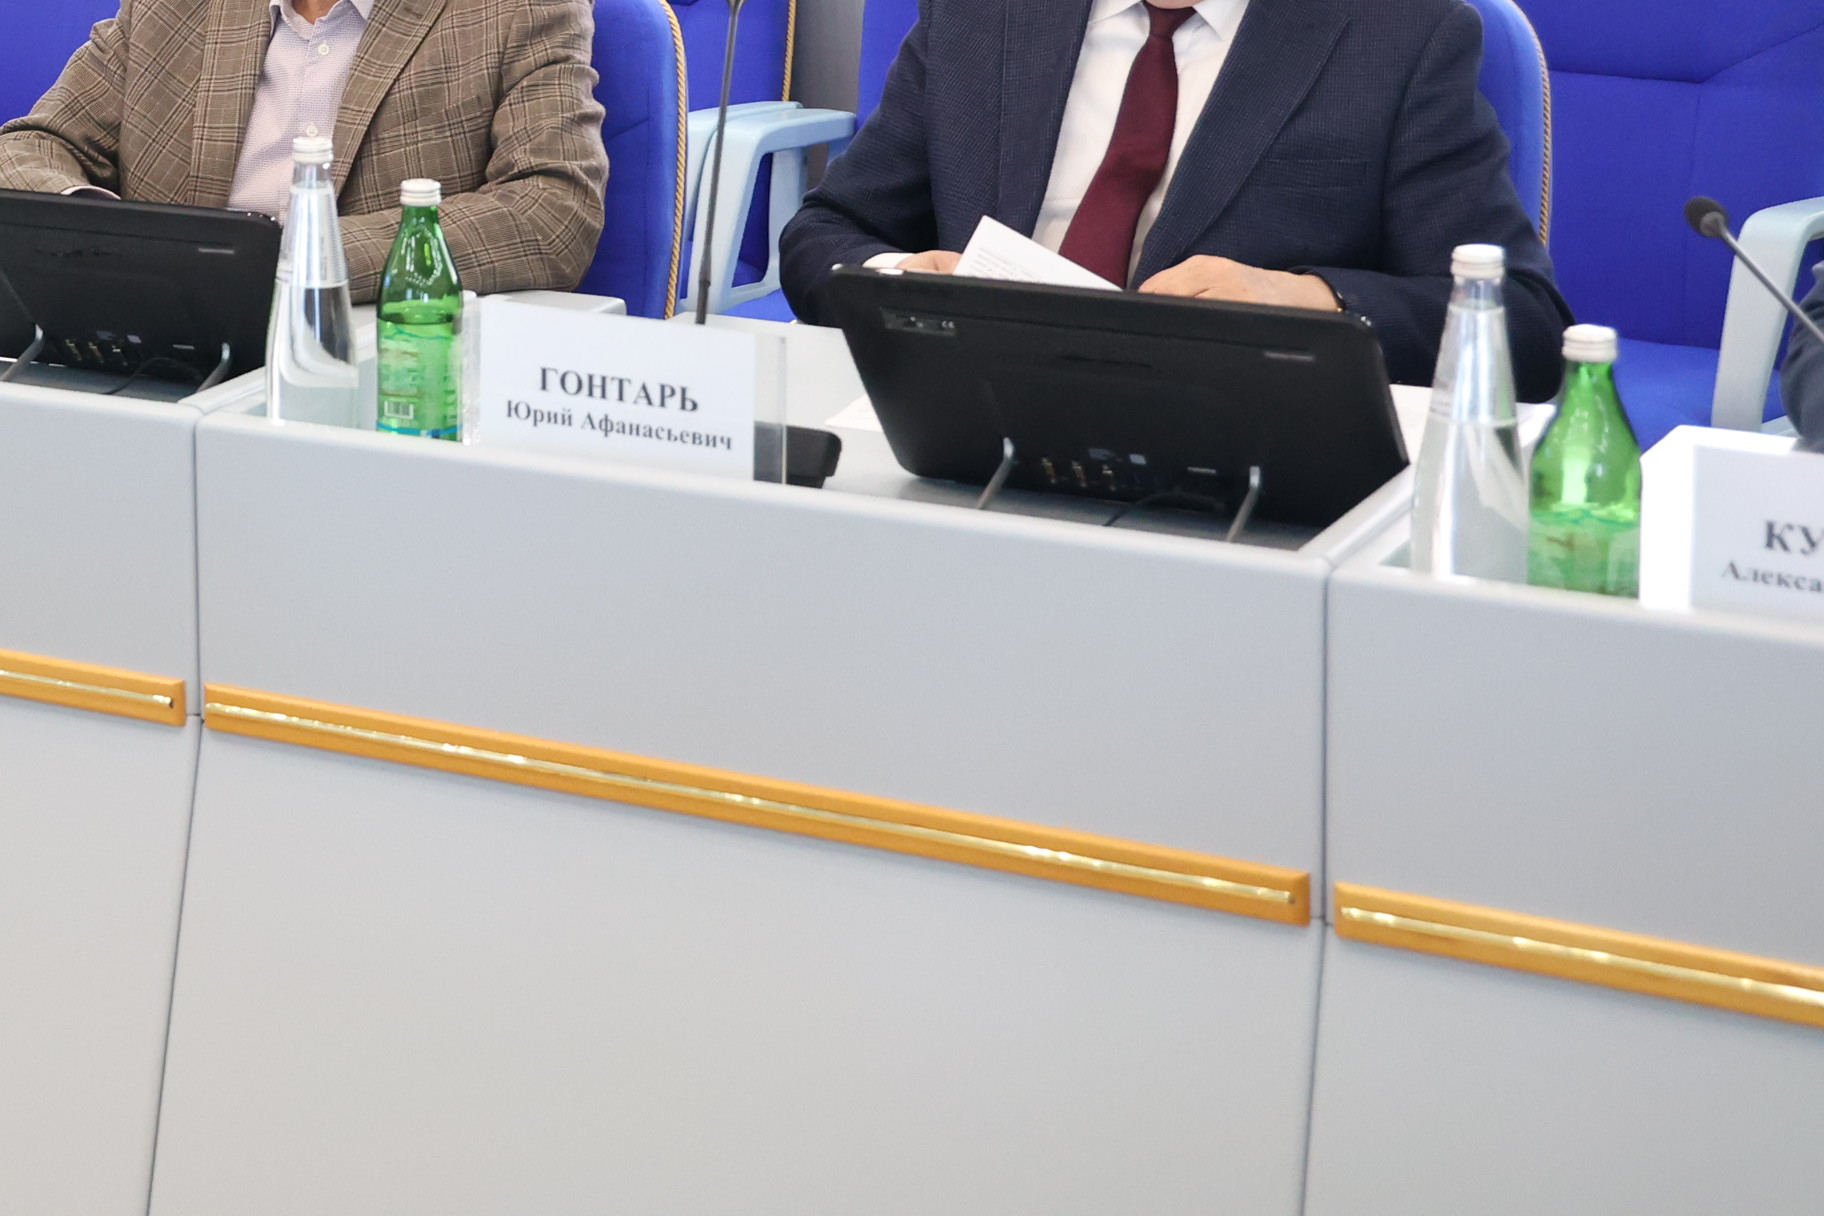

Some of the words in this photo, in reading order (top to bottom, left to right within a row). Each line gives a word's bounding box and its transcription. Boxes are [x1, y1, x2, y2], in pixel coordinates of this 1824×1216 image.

[539, 367, 700, 413] ГОНТАРЬ
[506, 399, 574, 427] Юрий
[580, 412, 733, 450] Афанасьевич
